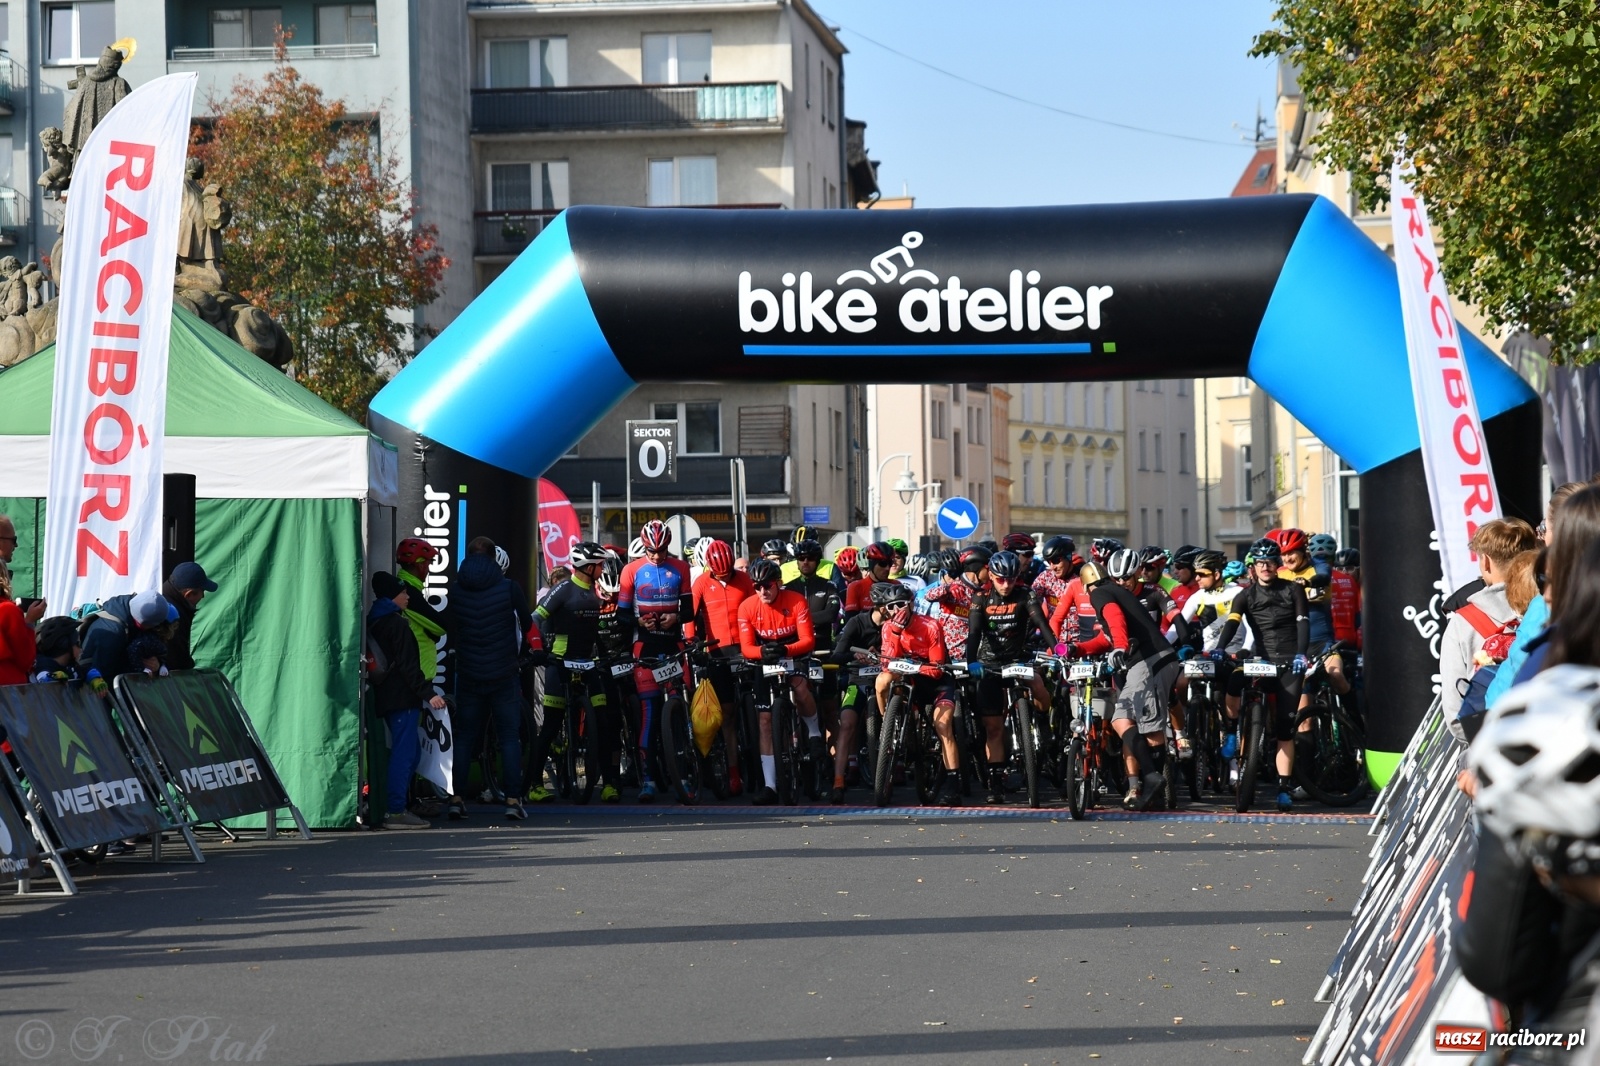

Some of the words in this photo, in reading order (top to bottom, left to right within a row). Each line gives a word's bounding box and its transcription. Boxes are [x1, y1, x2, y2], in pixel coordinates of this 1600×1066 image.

[738, 271, 877, 333] bike
[899, 269, 1114, 332] atelier
[77, 140, 156, 578] RACIBÓRZ
[634, 428, 671, 437] SEKTOR
[639, 439, 666, 478] 0
[617, 663, 634, 673] 100
[657, 665, 678, 679] 1120
[1071, 666, 1092, 674] 1184
[180, 758, 262, 794] MERIDA
[52, 777, 146, 818] MERDA
